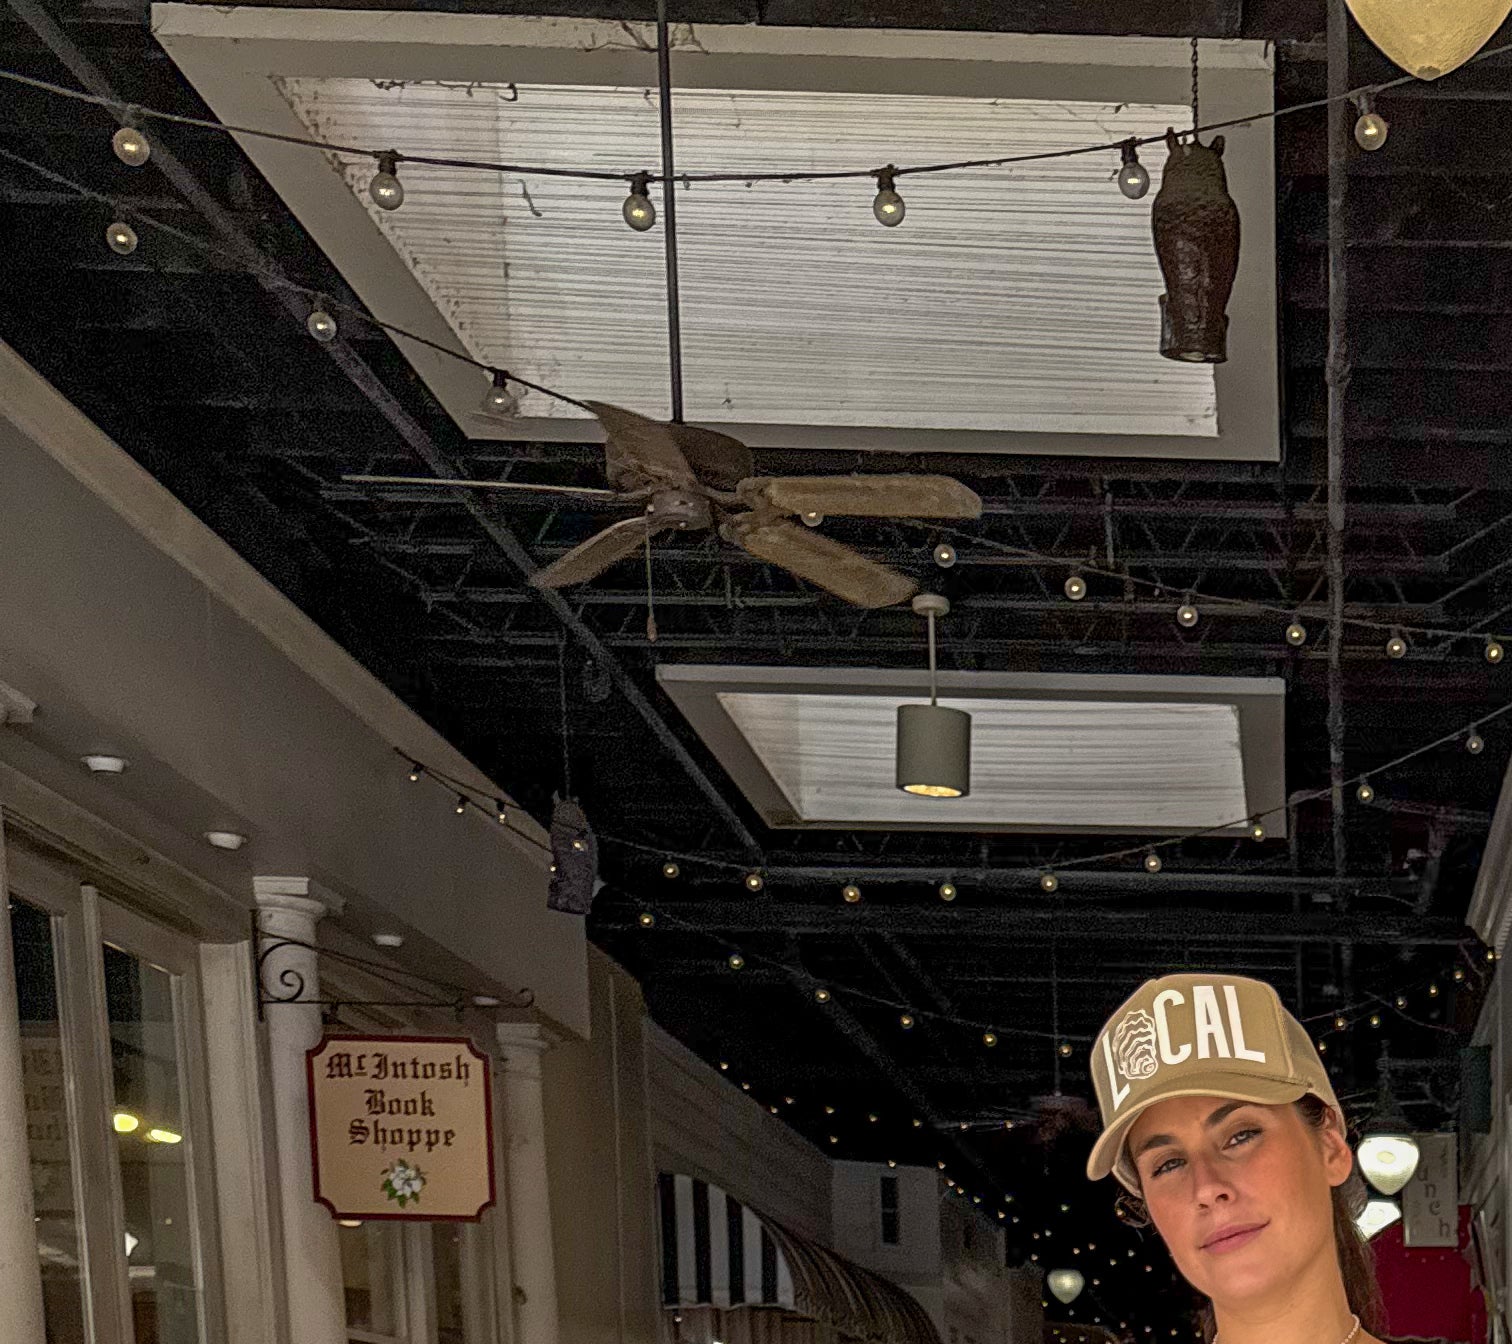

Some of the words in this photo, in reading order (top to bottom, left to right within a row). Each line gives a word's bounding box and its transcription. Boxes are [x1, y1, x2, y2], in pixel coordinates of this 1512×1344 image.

[1102, 985, 1266, 1112] LCAL
[326, 1053, 470, 1087] McIntosh
[363, 1088, 435, 1117] Book
[348, 1118, 456, 1152] Shoppe
